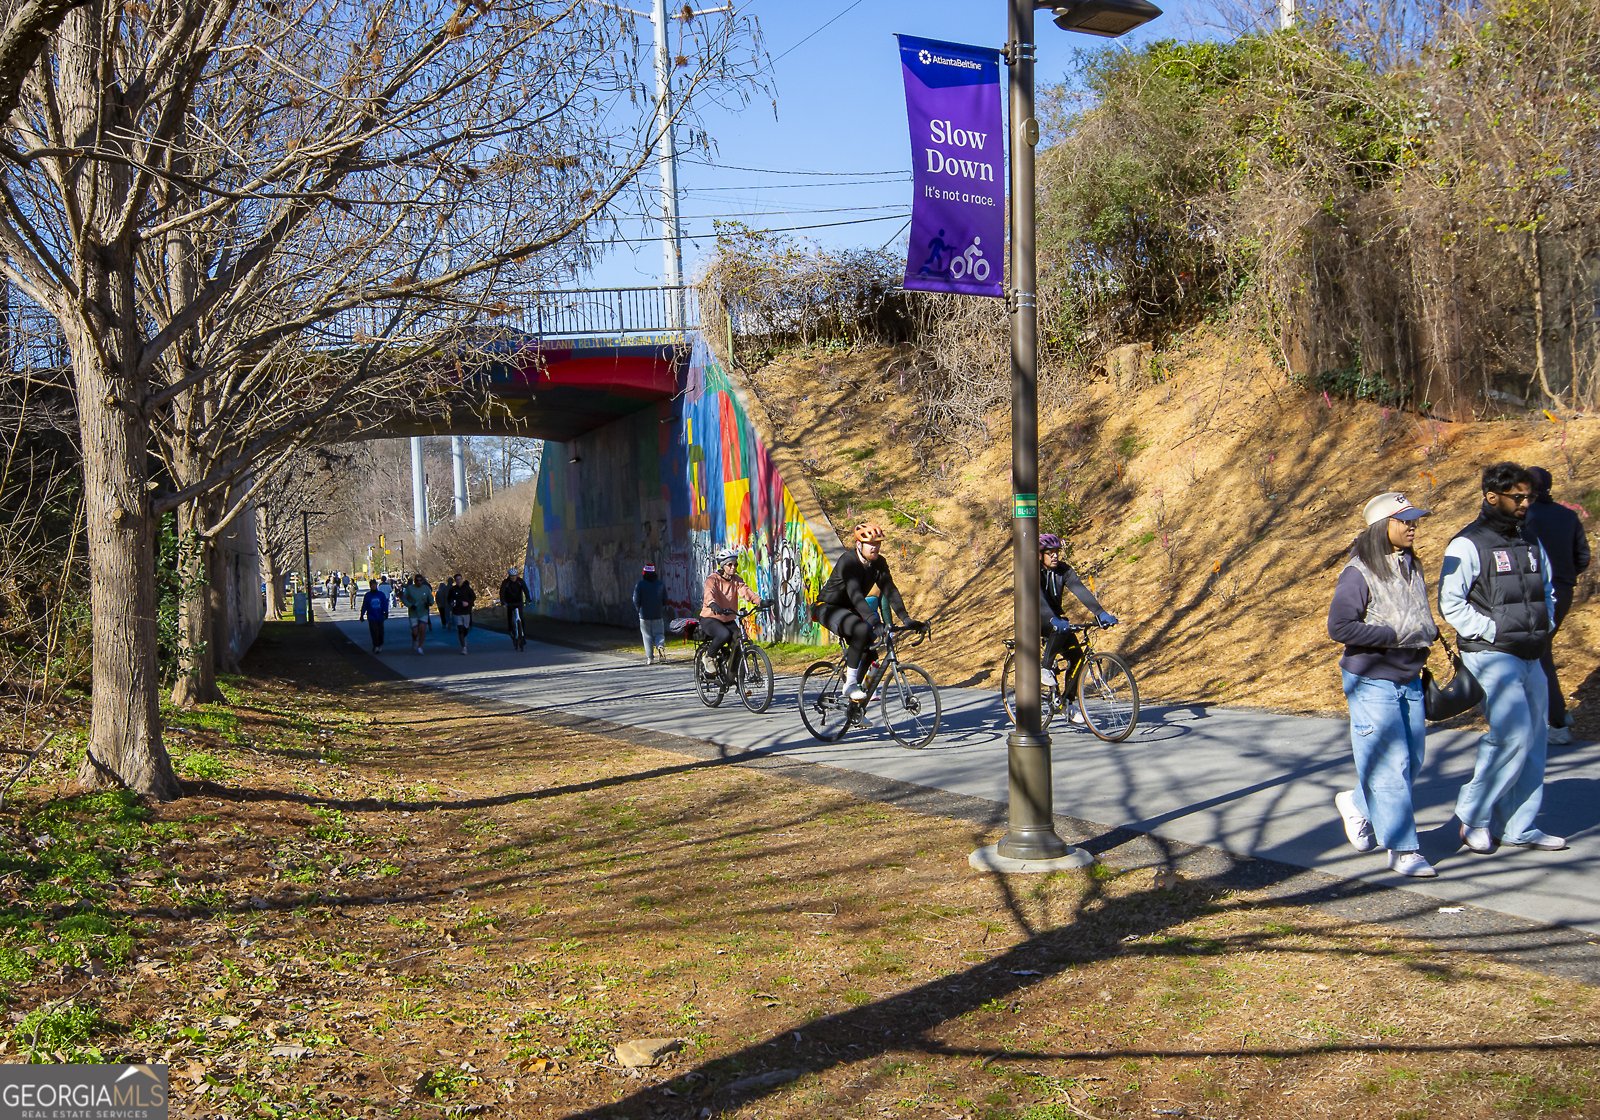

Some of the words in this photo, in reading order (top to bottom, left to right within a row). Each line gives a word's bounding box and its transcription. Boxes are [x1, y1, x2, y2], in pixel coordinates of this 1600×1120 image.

[932, 55, 982, 70] AtlantaBeltline
[930, 119, 987, 150] Slow
[925, 148, 994, 182] Down
[925, 185, 941, 199] It's
[942, 190, 960, 202] not
[962, 193, 969, 203] a
[971, 194, 996, 207] race.
